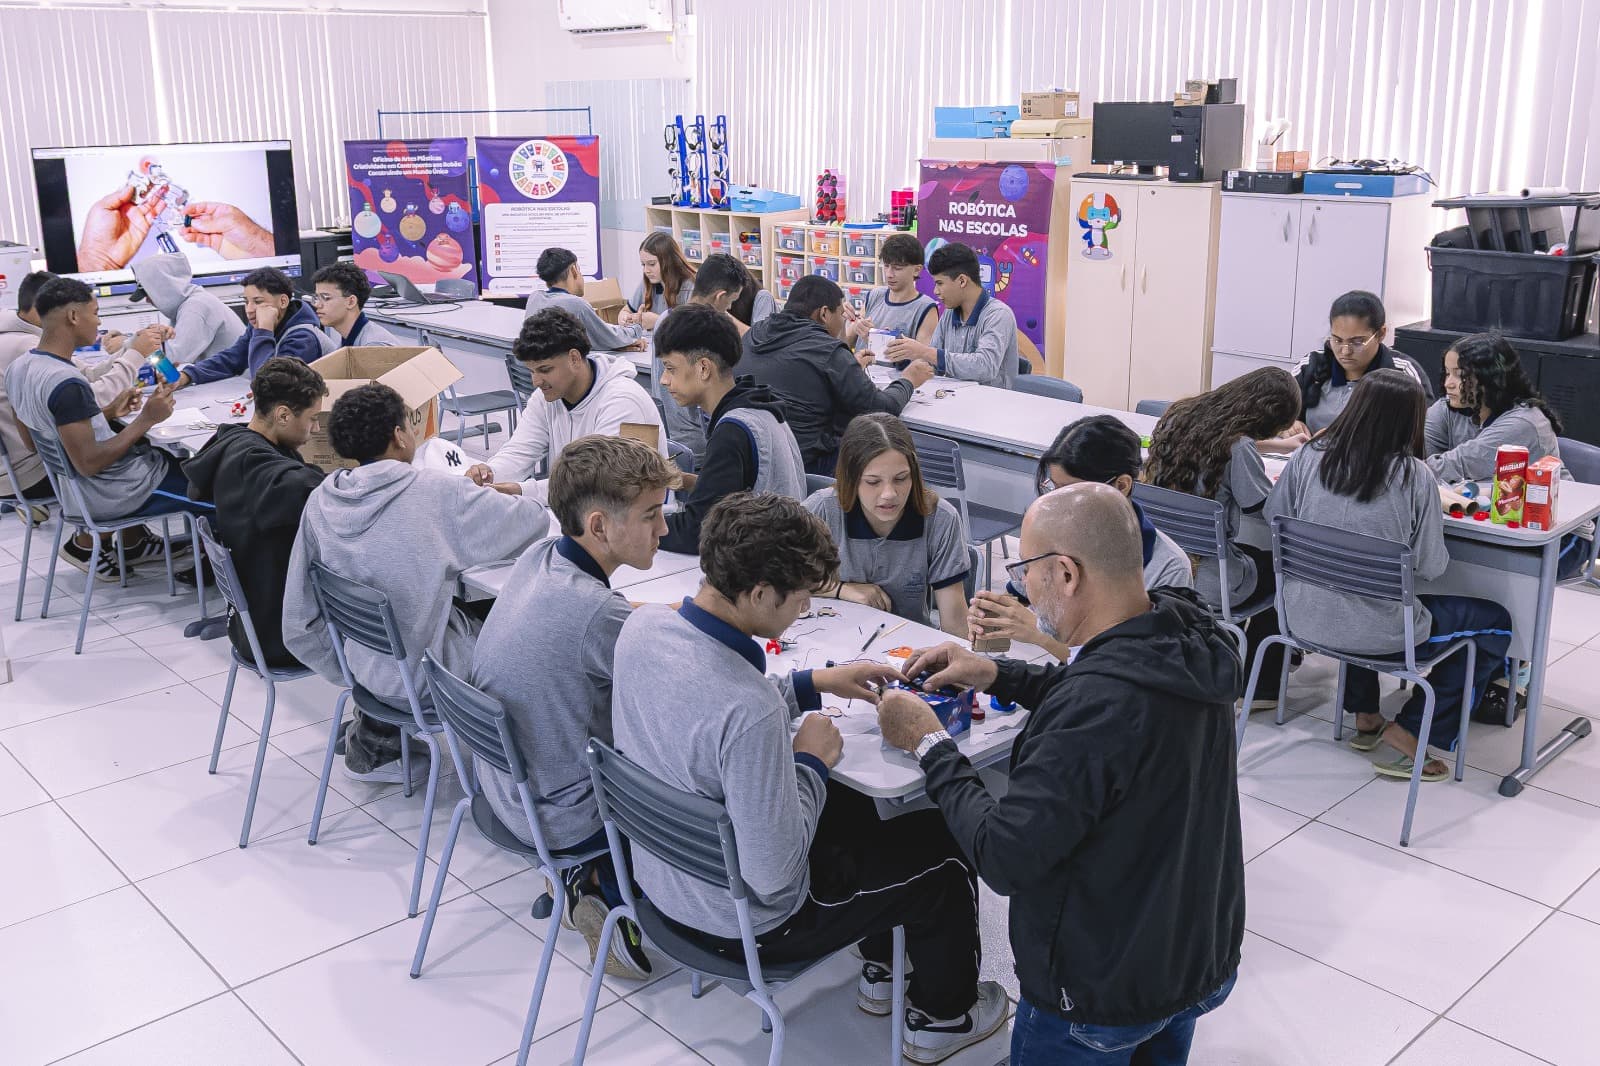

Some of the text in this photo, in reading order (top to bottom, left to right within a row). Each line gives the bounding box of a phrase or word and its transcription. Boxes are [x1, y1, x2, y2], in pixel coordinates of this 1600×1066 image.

[949, 200, 1016, 218] ROBÓTICA
[939, 219, 1028, 238] NAS ESCOLAS
[1500, 462, 1525, 472] MAGUARY
